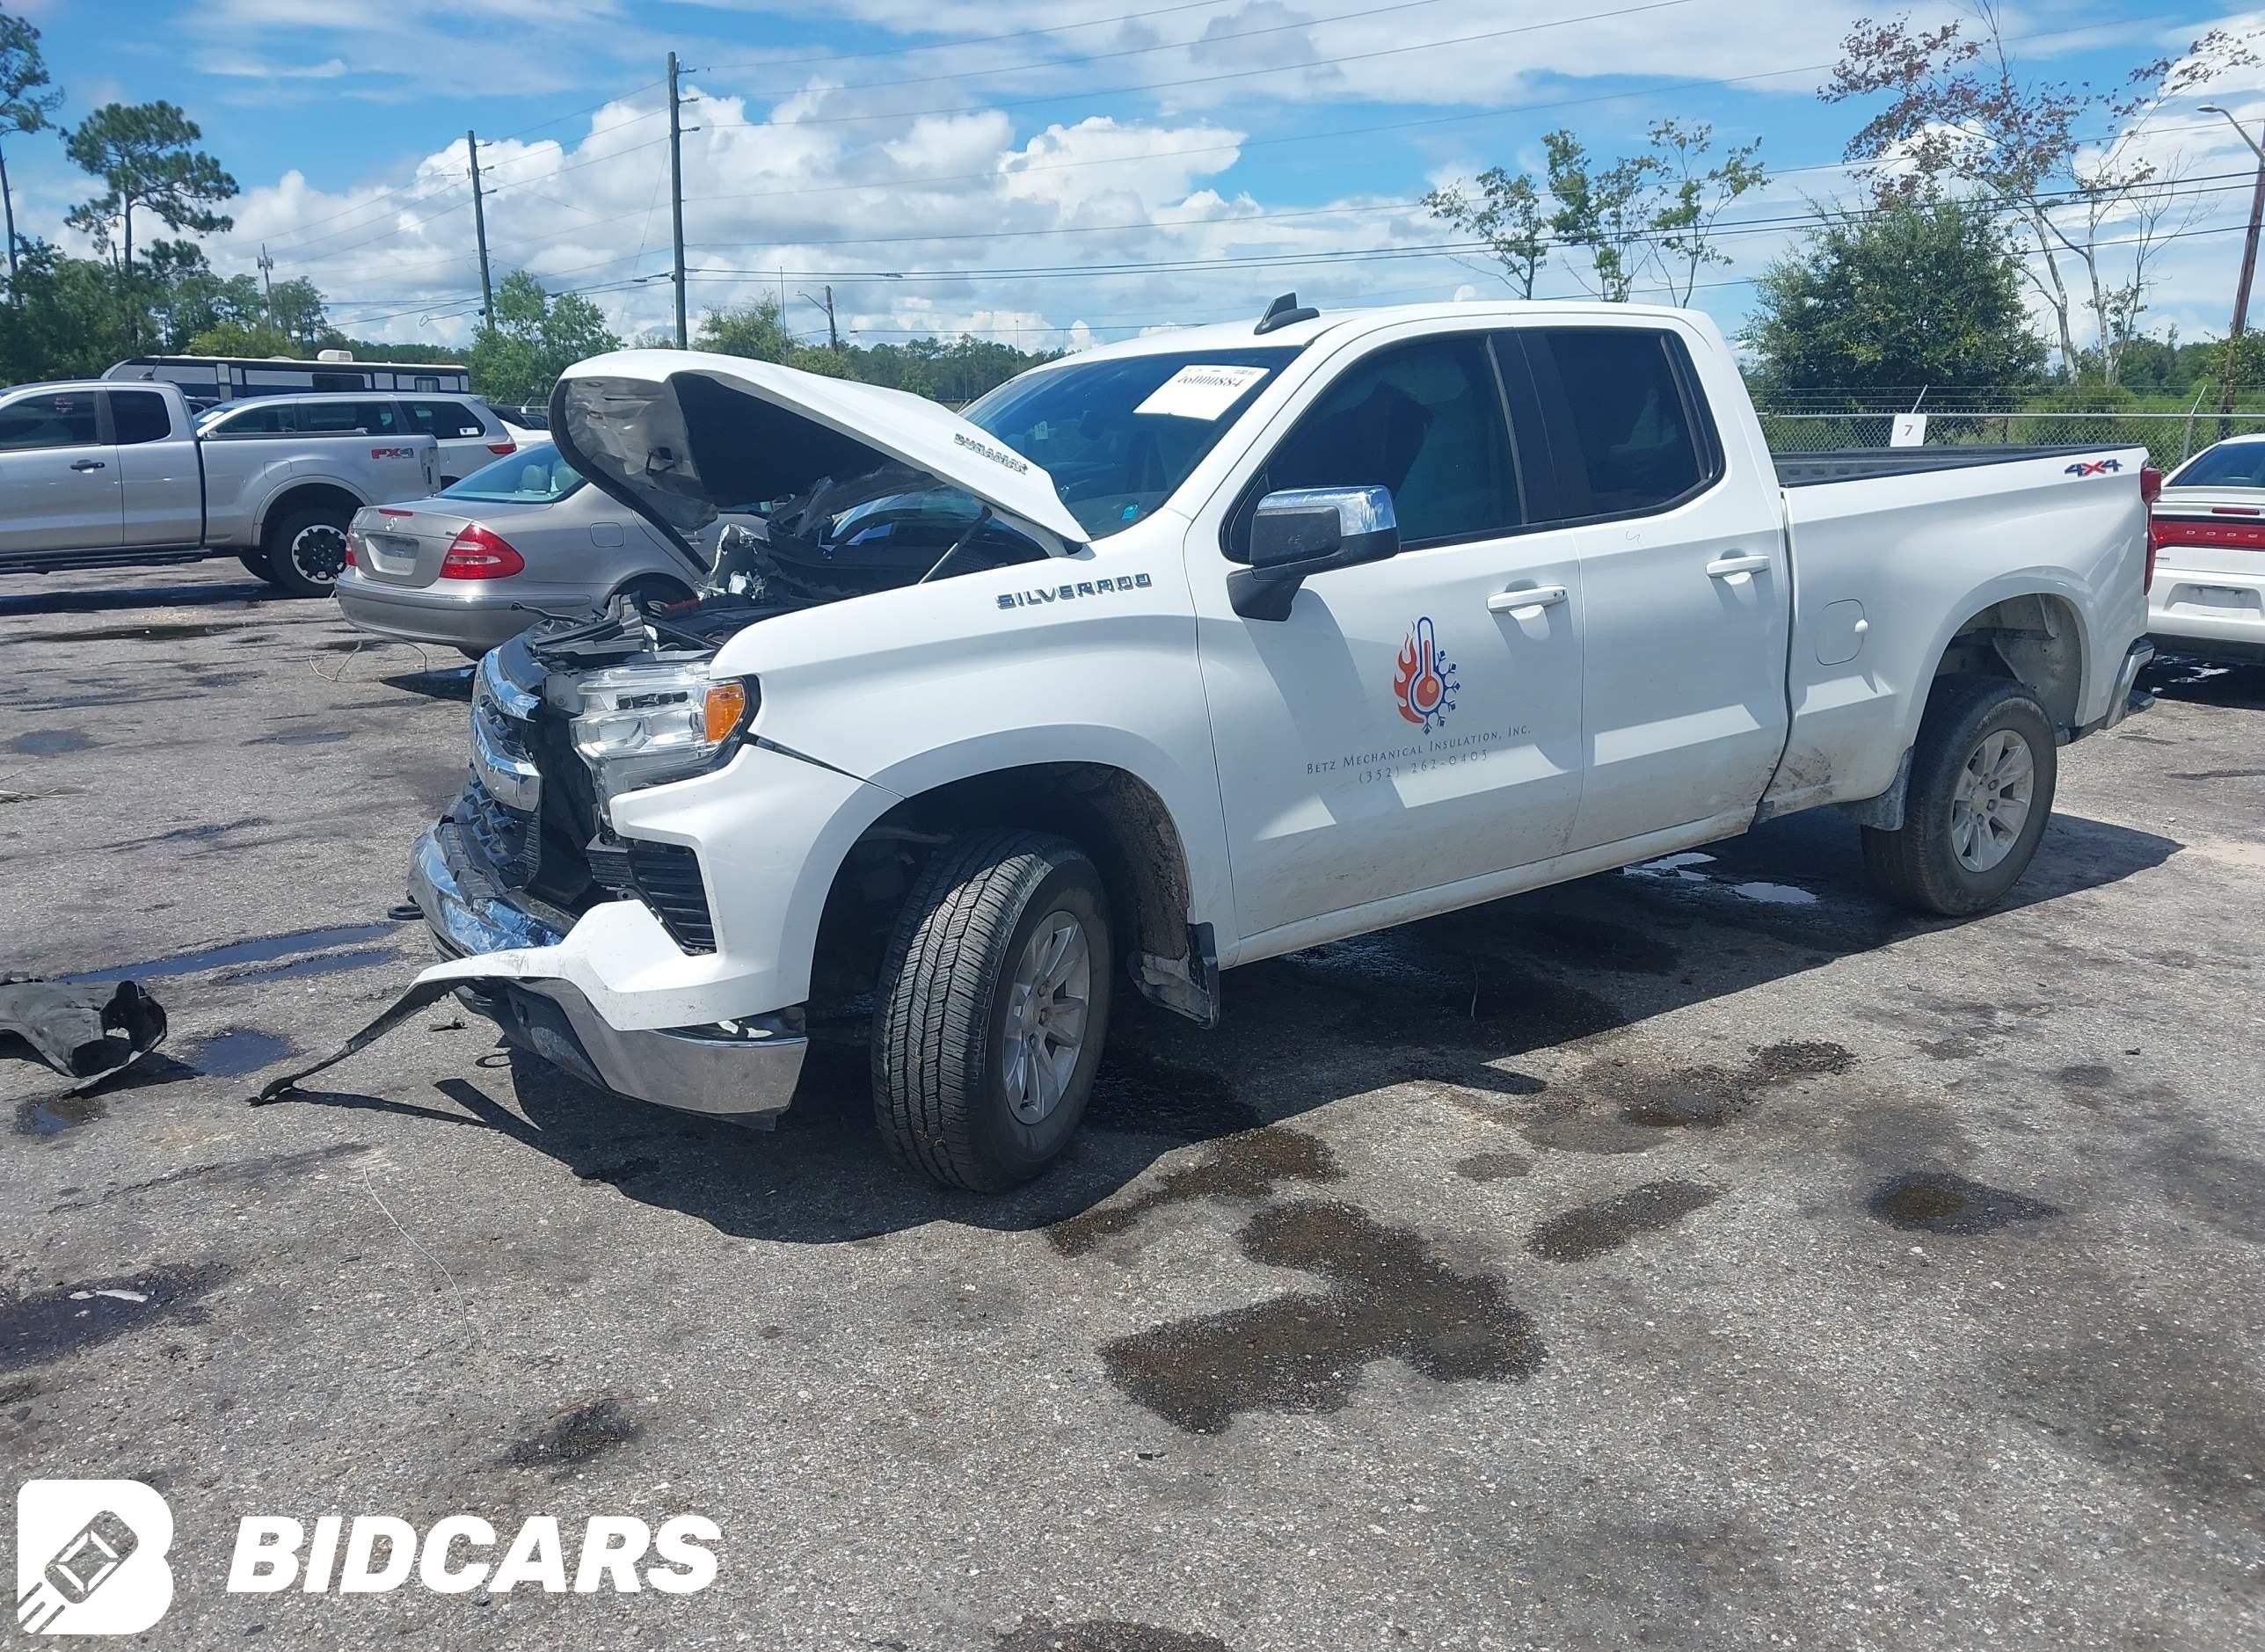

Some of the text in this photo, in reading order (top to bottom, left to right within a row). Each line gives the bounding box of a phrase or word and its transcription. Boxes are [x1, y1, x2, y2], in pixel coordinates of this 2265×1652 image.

[1903, 424, 1913, 436] 7
[371, 448, 414, 459] FX4
[996, 572, 1152, 610] SILVERADO
[1358, 765, 1401, 784] (352)
